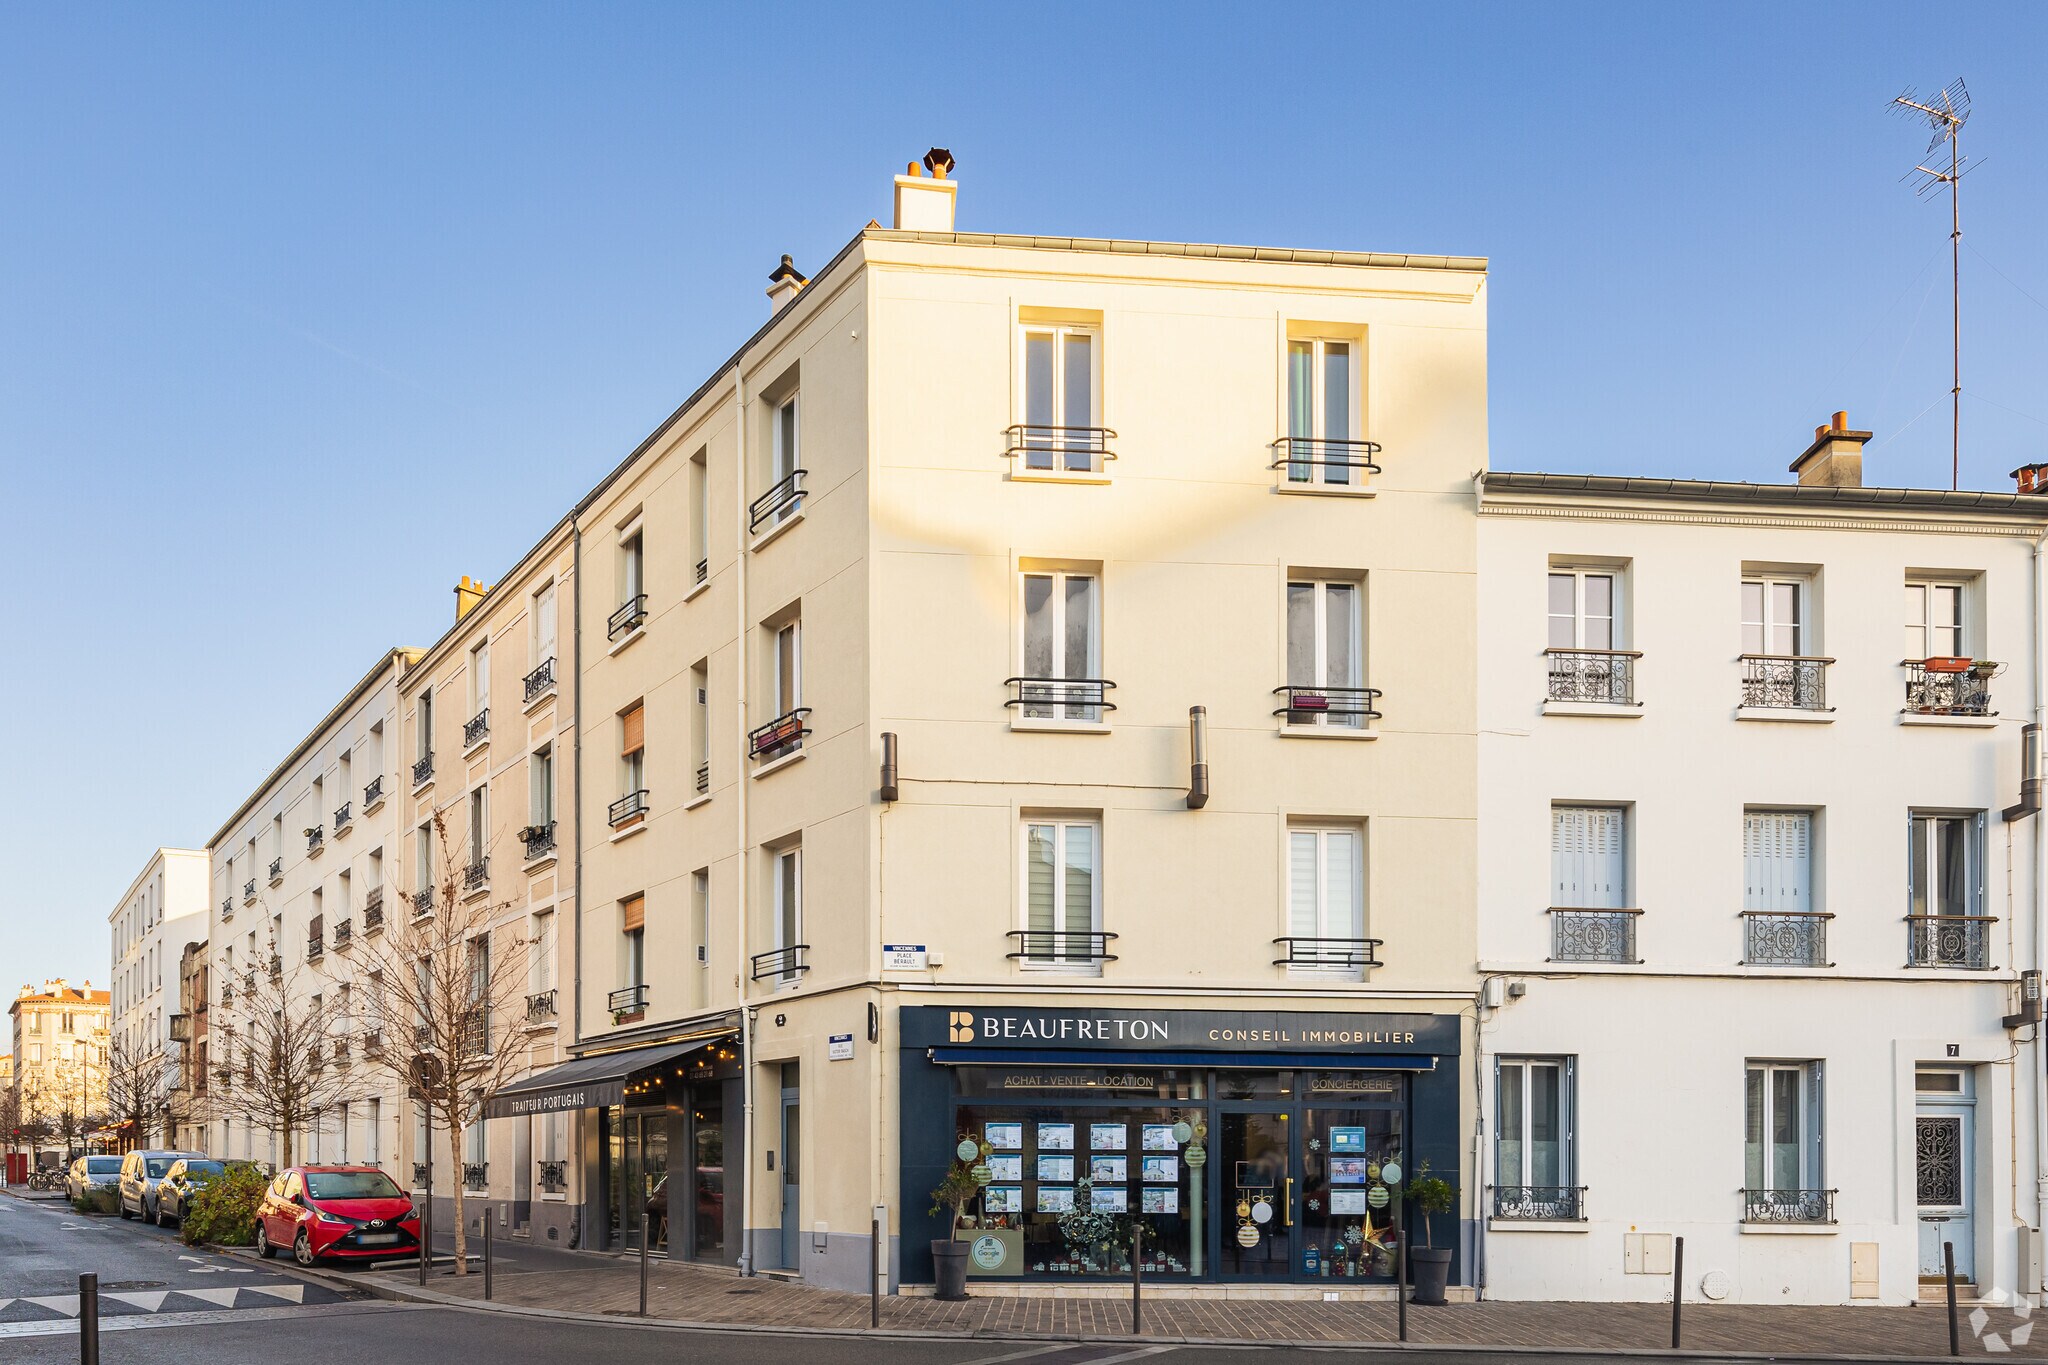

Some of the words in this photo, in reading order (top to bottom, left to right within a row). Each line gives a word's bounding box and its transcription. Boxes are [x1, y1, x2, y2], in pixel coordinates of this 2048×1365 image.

[983, 1017, 1169, 1040] BEAUFRETON
[1209, 1029, 1291, 1042] CONSEIL
[1302, 1031, 1415, 1044] IMMOBILIER
[1950, 1045, 1956, 1056] 7
[1004, 1075, 1042, 1086] ACHAT
[1050, 1075, 1087, 1086] VENTE
[1097, 1076, 1154, 1087] LOCATION
[1311, 1079, 1393, 1090] CONCIERGERIE
[512, 1098, 542, 1113] TRAITEUR
[543, 1092, 585, 1110] PORTUGAIS
